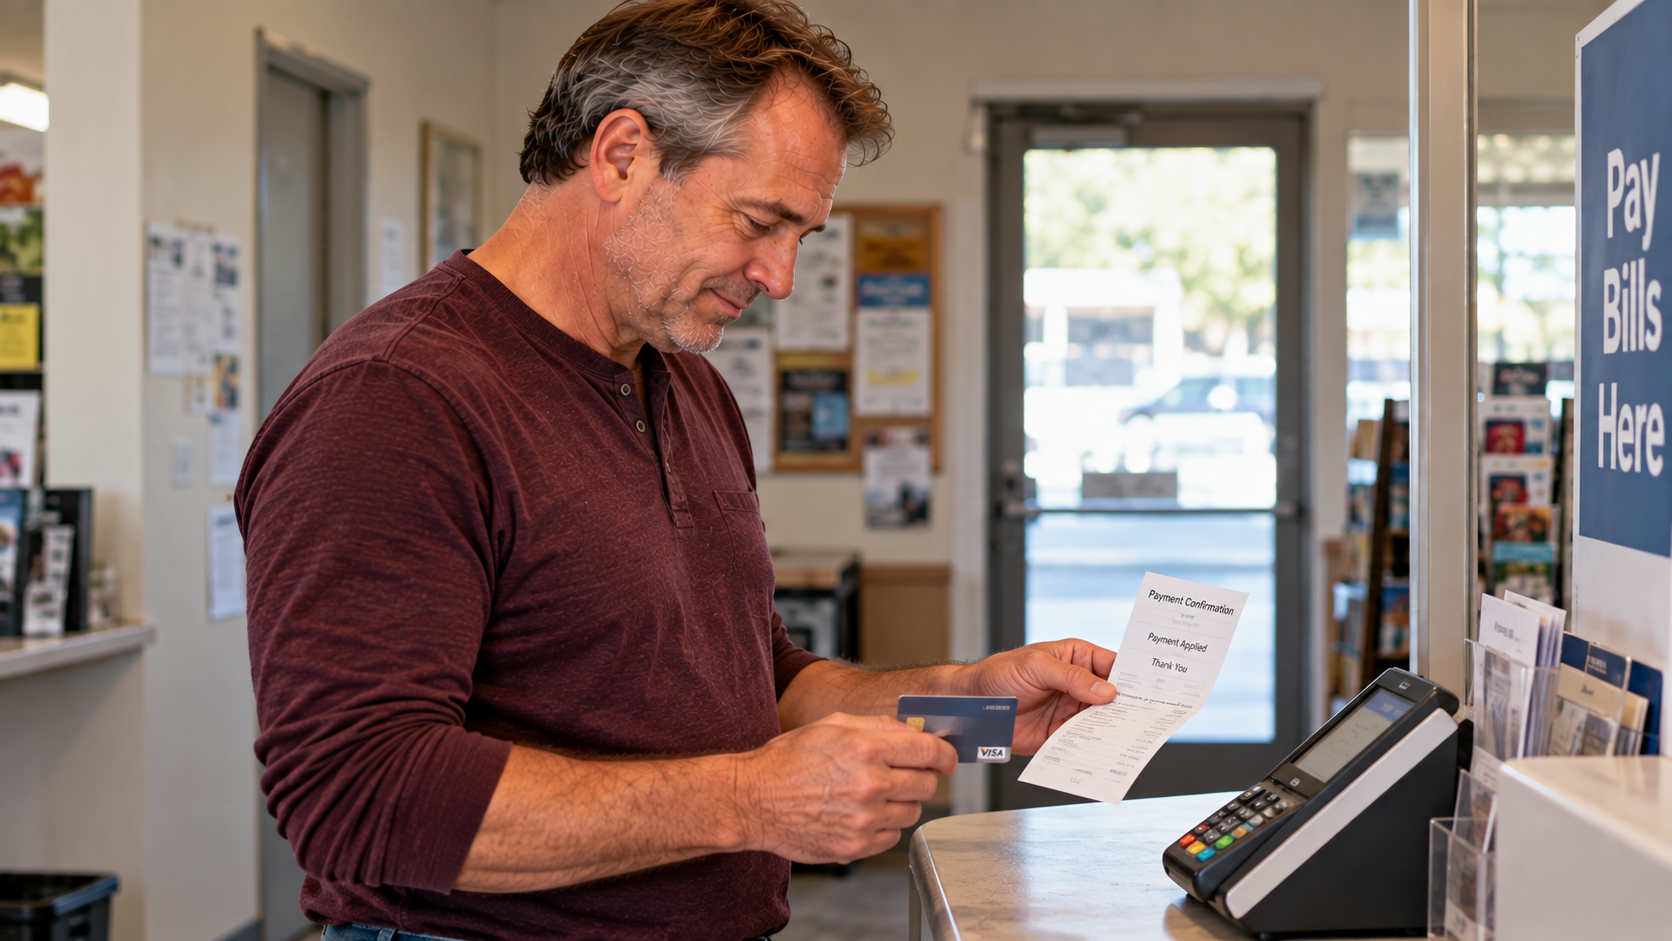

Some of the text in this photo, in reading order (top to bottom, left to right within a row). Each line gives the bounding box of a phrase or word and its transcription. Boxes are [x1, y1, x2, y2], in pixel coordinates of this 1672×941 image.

[1607, 148, 1660, 251] Pay
[1603, 258, 1662, 354] Bills
[1598, 382, 1665, 477] Here
[1148, 590, 1234, 615] Payment Confirmation
[1148, 632, 1208, 652] Payment Applied
[1152, 658, 1188, 673] Thank You
[981, 748, 1003, 757] VISA
